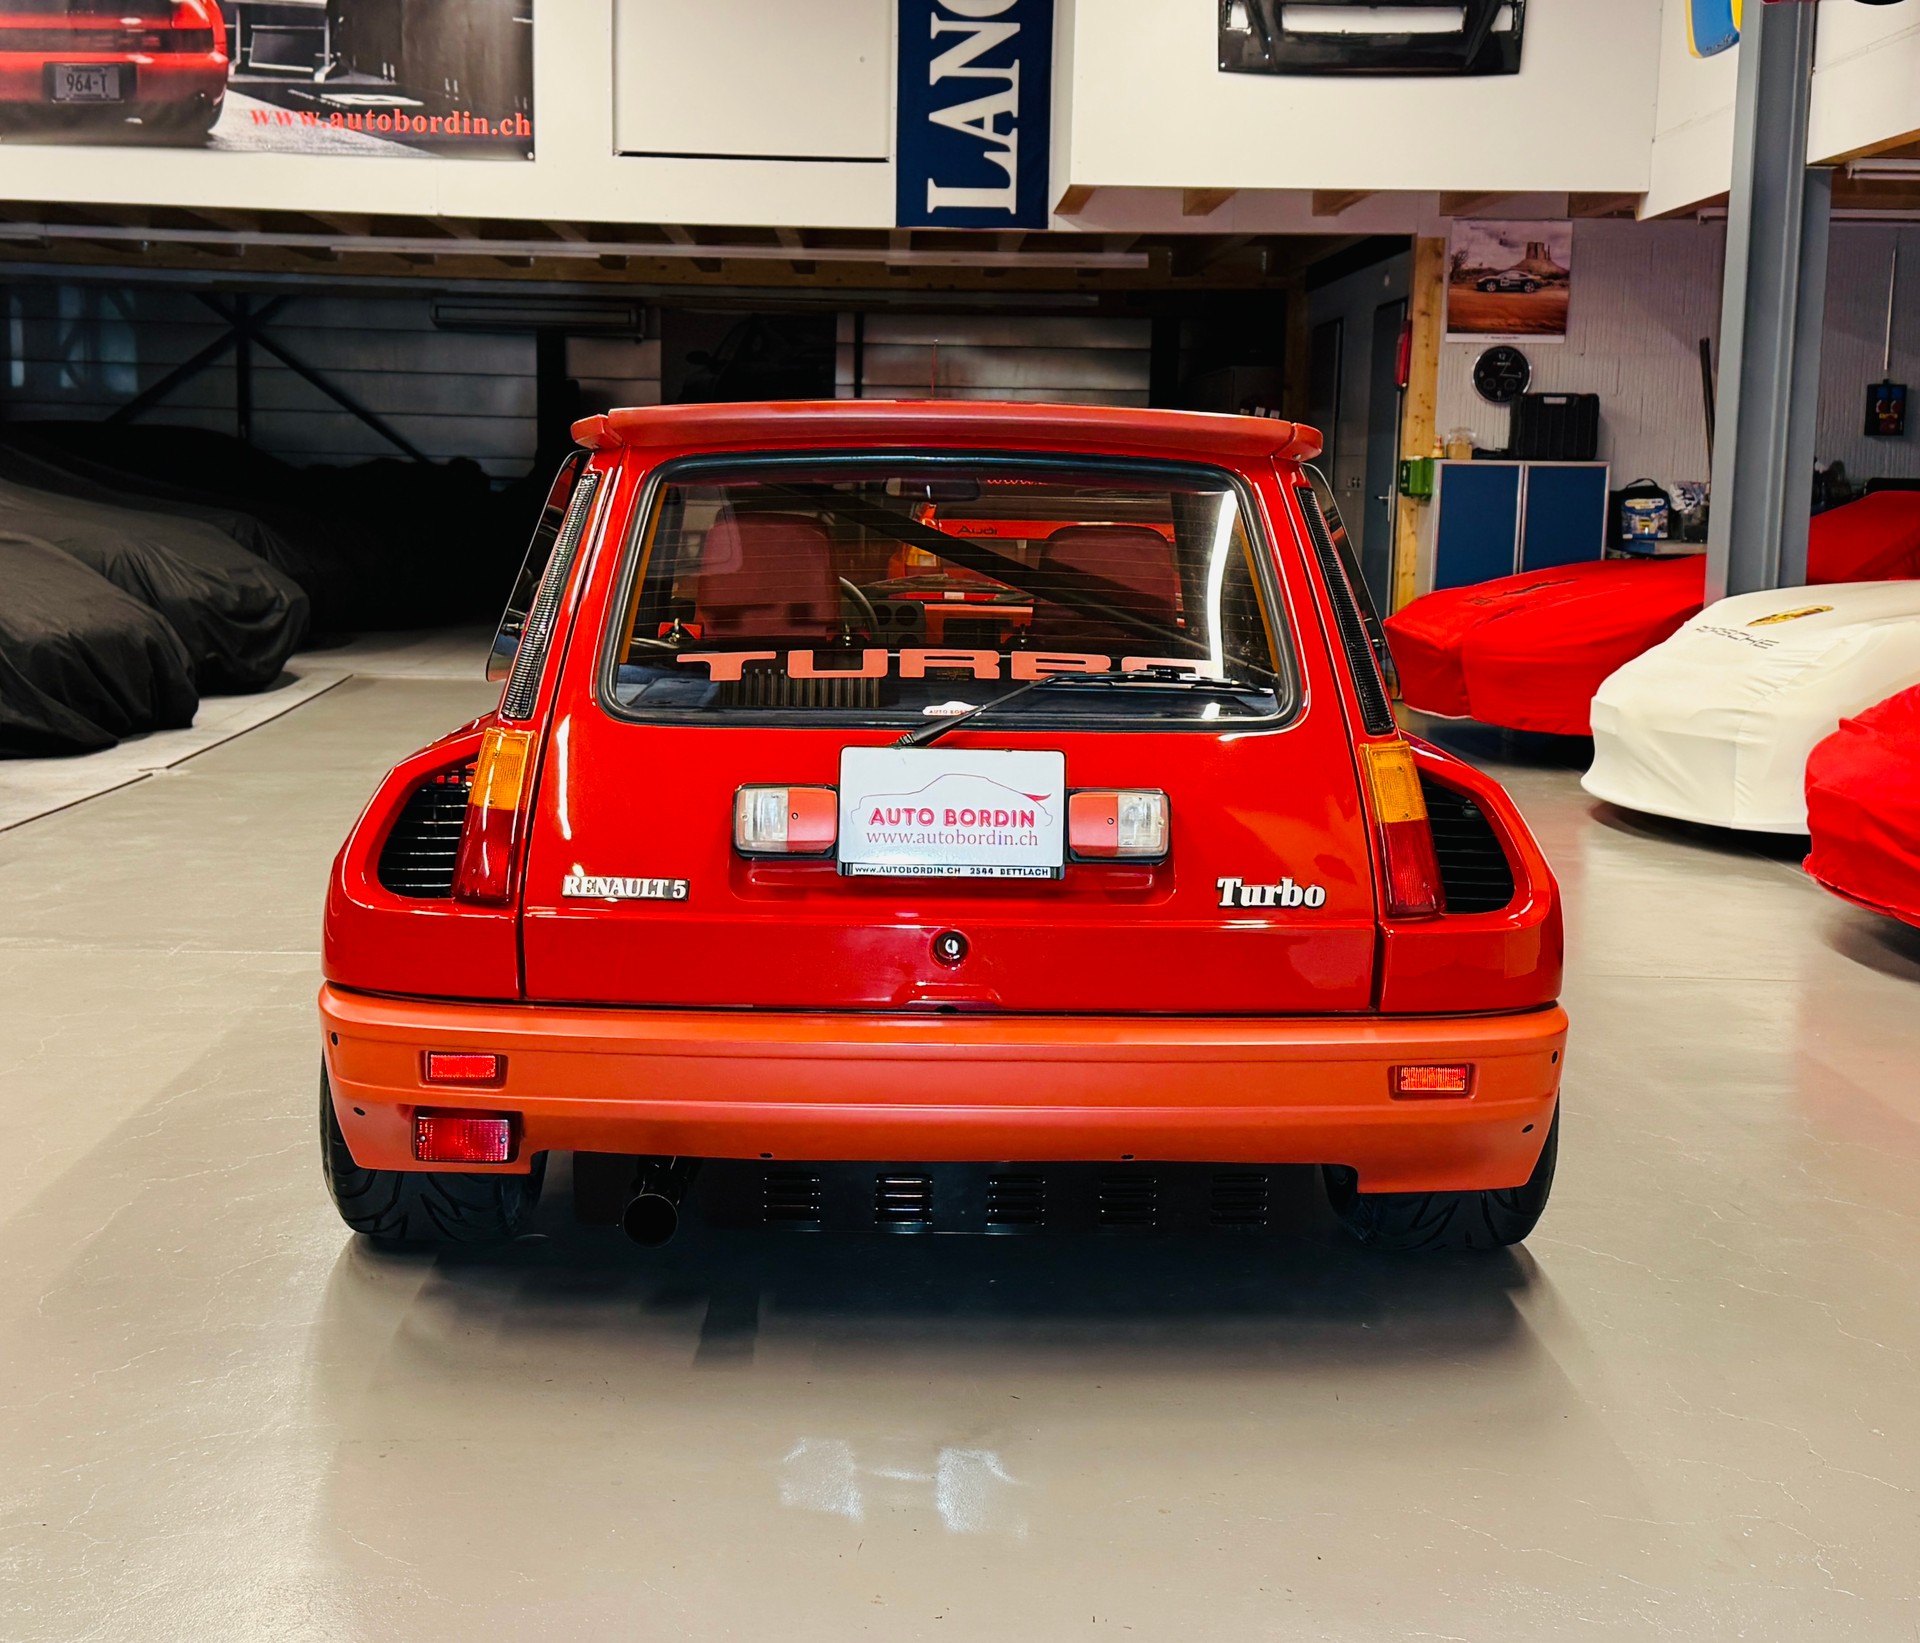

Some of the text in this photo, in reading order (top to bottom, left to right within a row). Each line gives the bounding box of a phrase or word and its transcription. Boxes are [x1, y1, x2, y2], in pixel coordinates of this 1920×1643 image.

[927, 0, 1020, 215] LAN
[250, 109, 531, 136] www.autobordin.ch
[957, 525, 998, 535] Audi
[868, 807, 1035, 828] AUTO BORDIN
[866, 829, 1038, 847] www.autobordin.ch
[969, 867, 994, 875] 2544
[1000, 867, 1049, 876] BETTLACH
[563, 876, 687, 899] RENAULT 5
[1217, 876, 1326, 907] Turbo
